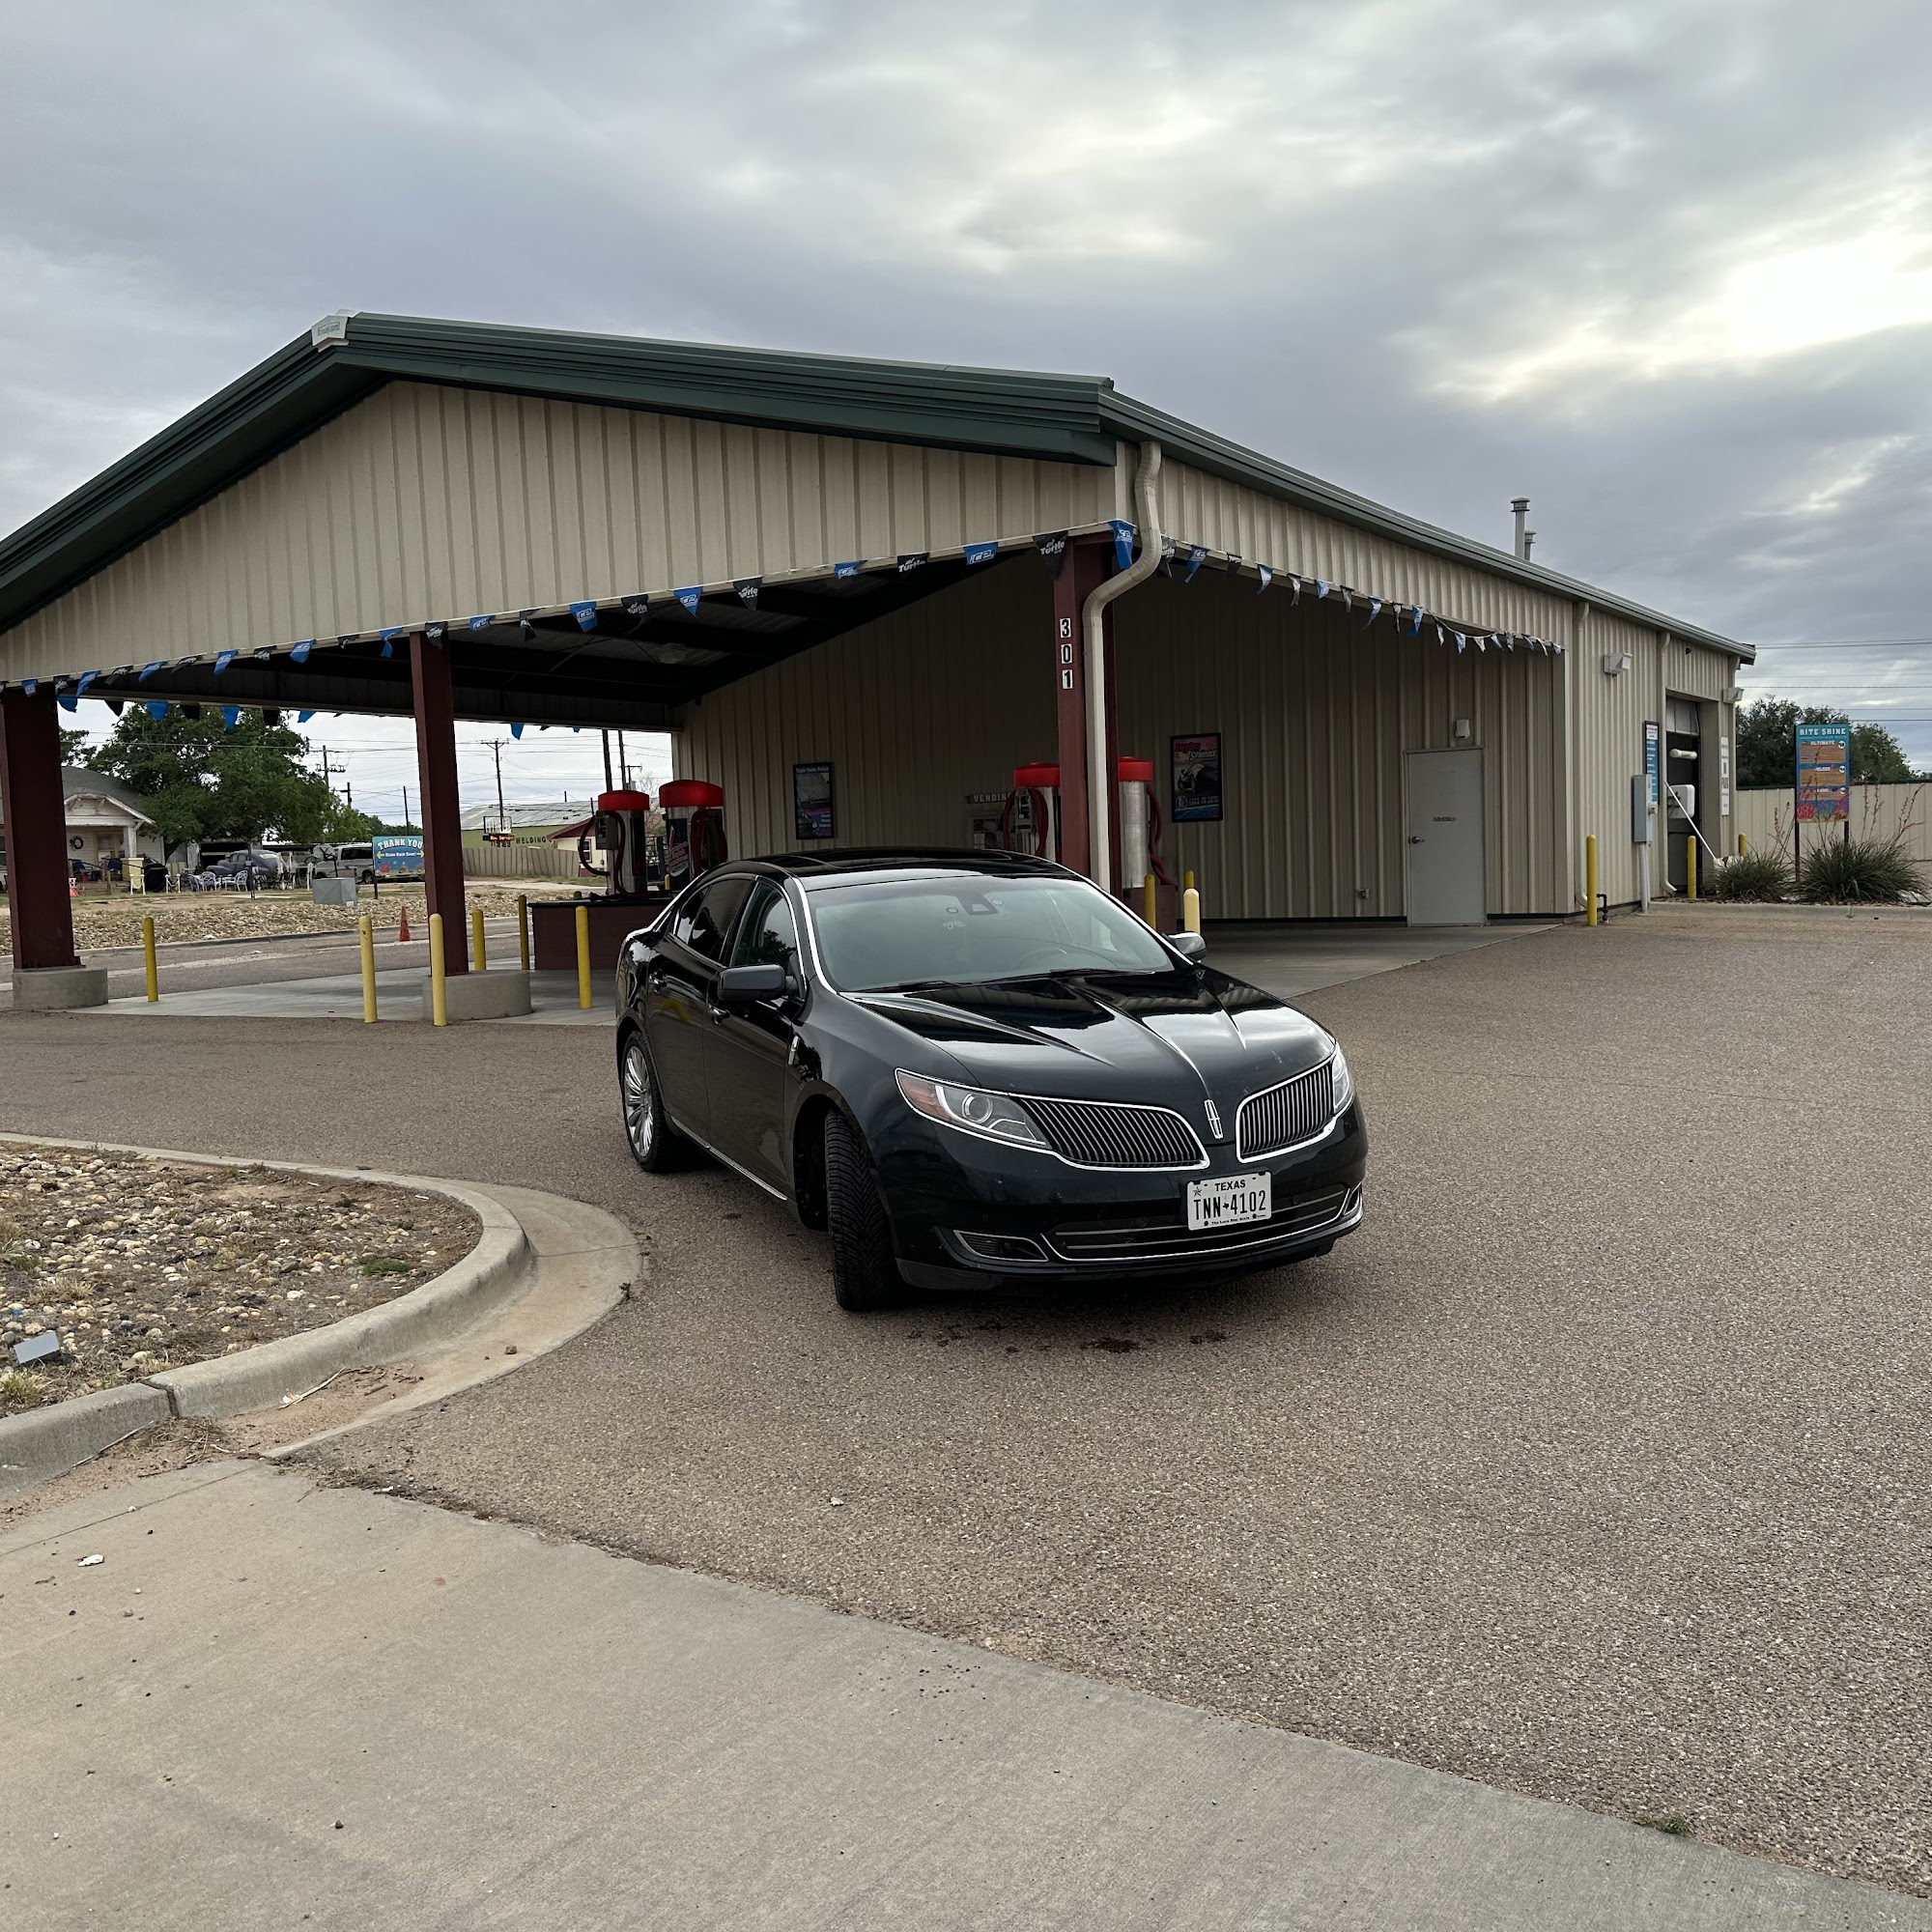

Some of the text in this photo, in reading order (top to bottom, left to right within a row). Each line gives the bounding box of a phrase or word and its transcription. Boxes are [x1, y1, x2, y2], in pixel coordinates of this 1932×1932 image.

[1040, 541, 1065, 555] Turtle
[898, 559, 926, 573] Turtle
[1062, 618, 1071, 688] 301
[1189, 750, 1217, 762] Shield
[973, 792, 1011, 803] VENDIN
[378, 838, 423, 850] THANK YOU
[1214, 1179, 1246, 1191] TEXAS
